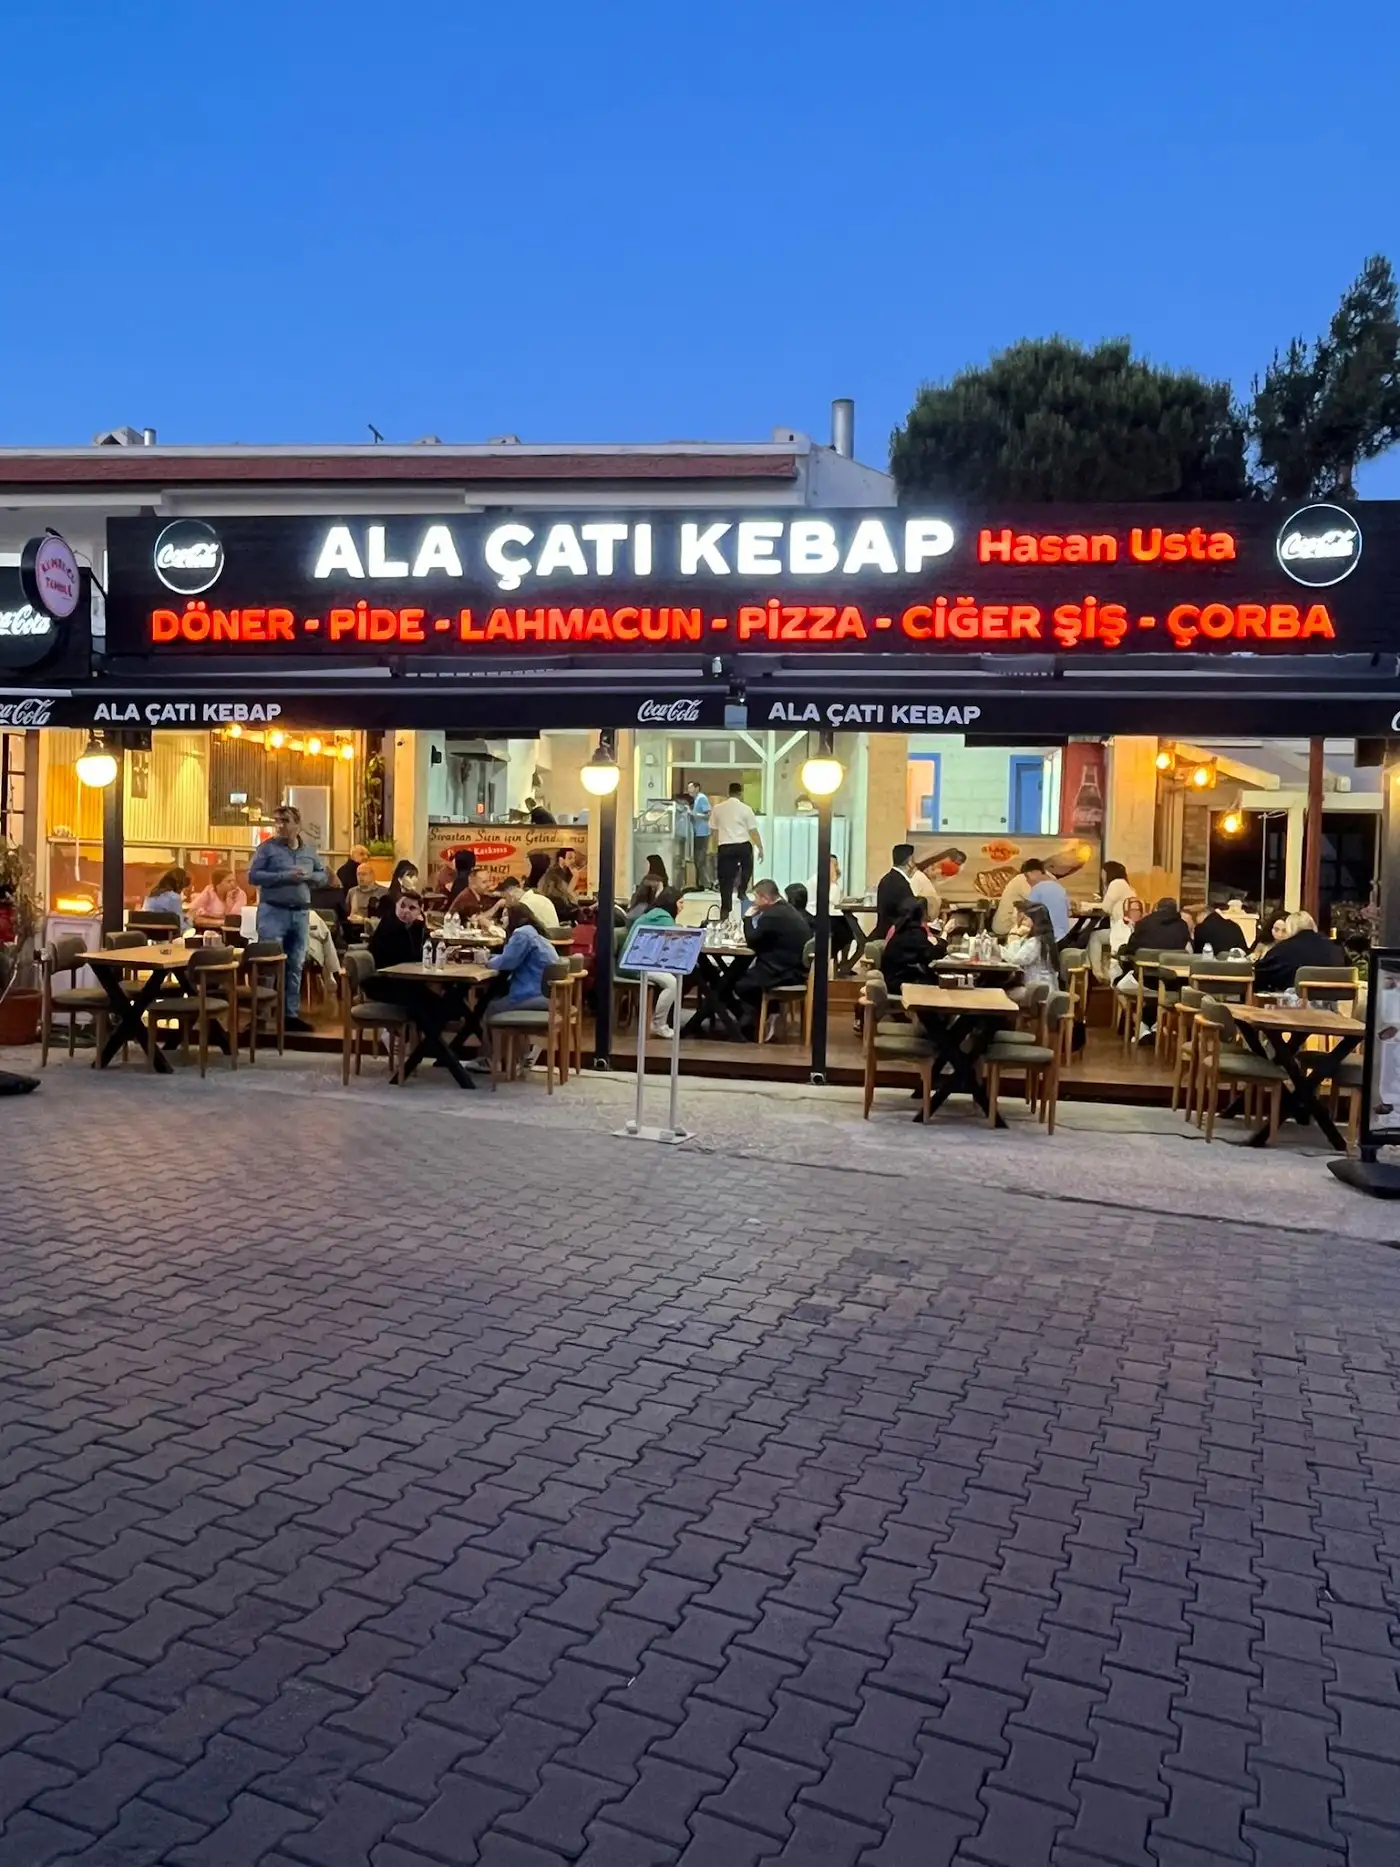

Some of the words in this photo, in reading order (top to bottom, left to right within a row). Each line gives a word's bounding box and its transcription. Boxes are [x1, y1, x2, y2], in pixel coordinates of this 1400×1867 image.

[314, 525, 463, 579] ALA
[484, 523, 652, 591] ÇATI
[680, 519, 955, 575] KEBAP
[978, 529, 1120, 563] Hasan
[1129, 527, 1236, 562] Usta
[151, 600, 295, 642] DÖNER
[329, 600, 426, 642] PİDE
[458, 606, 702, 642] LAHMACUN
[737, 599, 867, 641] PİZZA
[900, 596, 1044, 641] CİĞER
[1052, 595, 1131, 648] ŞİŞ
[1166, 602, 1336, 648] ÇORBA
[94, 703, 141, 721] ALA
[145, 703, 196, 726] ÇATI
[202, 703, 282, 721] KEBAP
[768, 701, 821, 722] ALA
[827, 703, 884, 727] ÇATI
[891, 704, 981, 725] KEBAP
